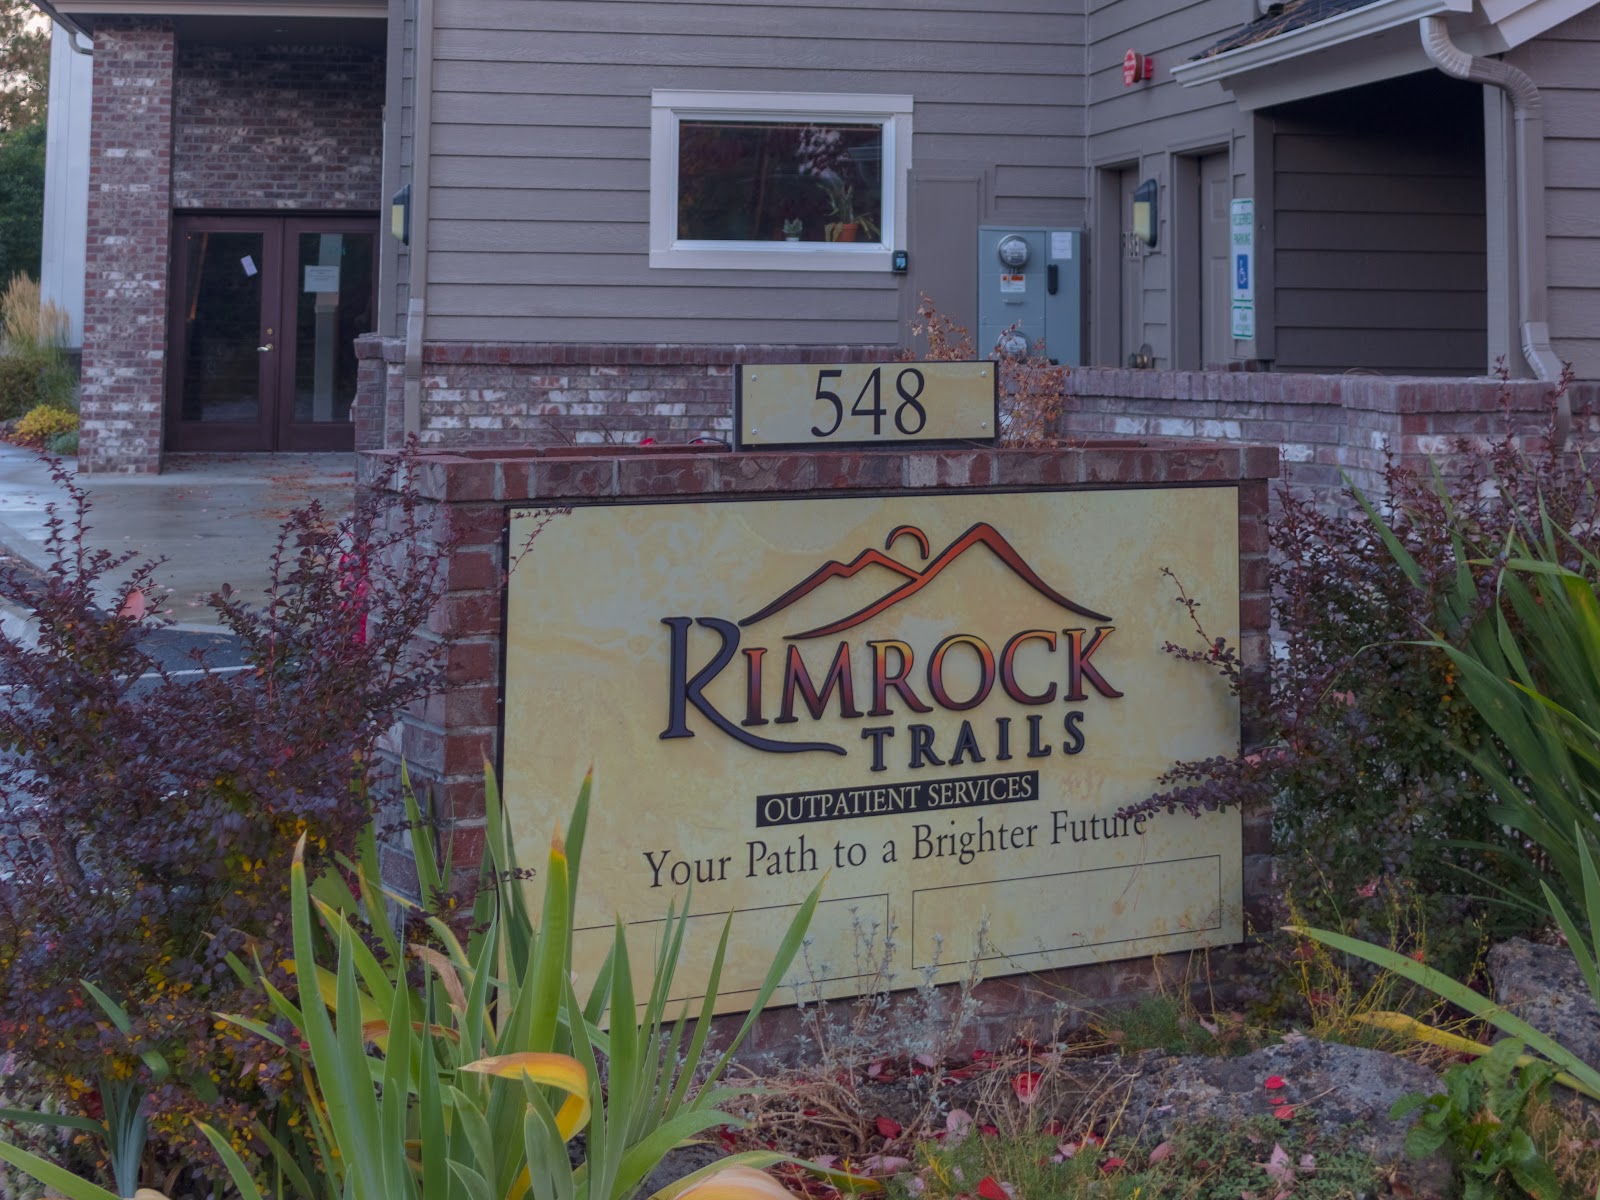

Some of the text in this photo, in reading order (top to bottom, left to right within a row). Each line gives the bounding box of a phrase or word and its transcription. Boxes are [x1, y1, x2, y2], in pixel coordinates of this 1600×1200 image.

[810, 367, 927, 438] 548
[659, 616, 1123, 756] RIMROCK
[861, 711, 1086, 772] TRAILS
[764, 774, 1033, 823] OUTPATIENT SERVICES
[643, 809, 1148, 888] Your Path to a Brighter Future
